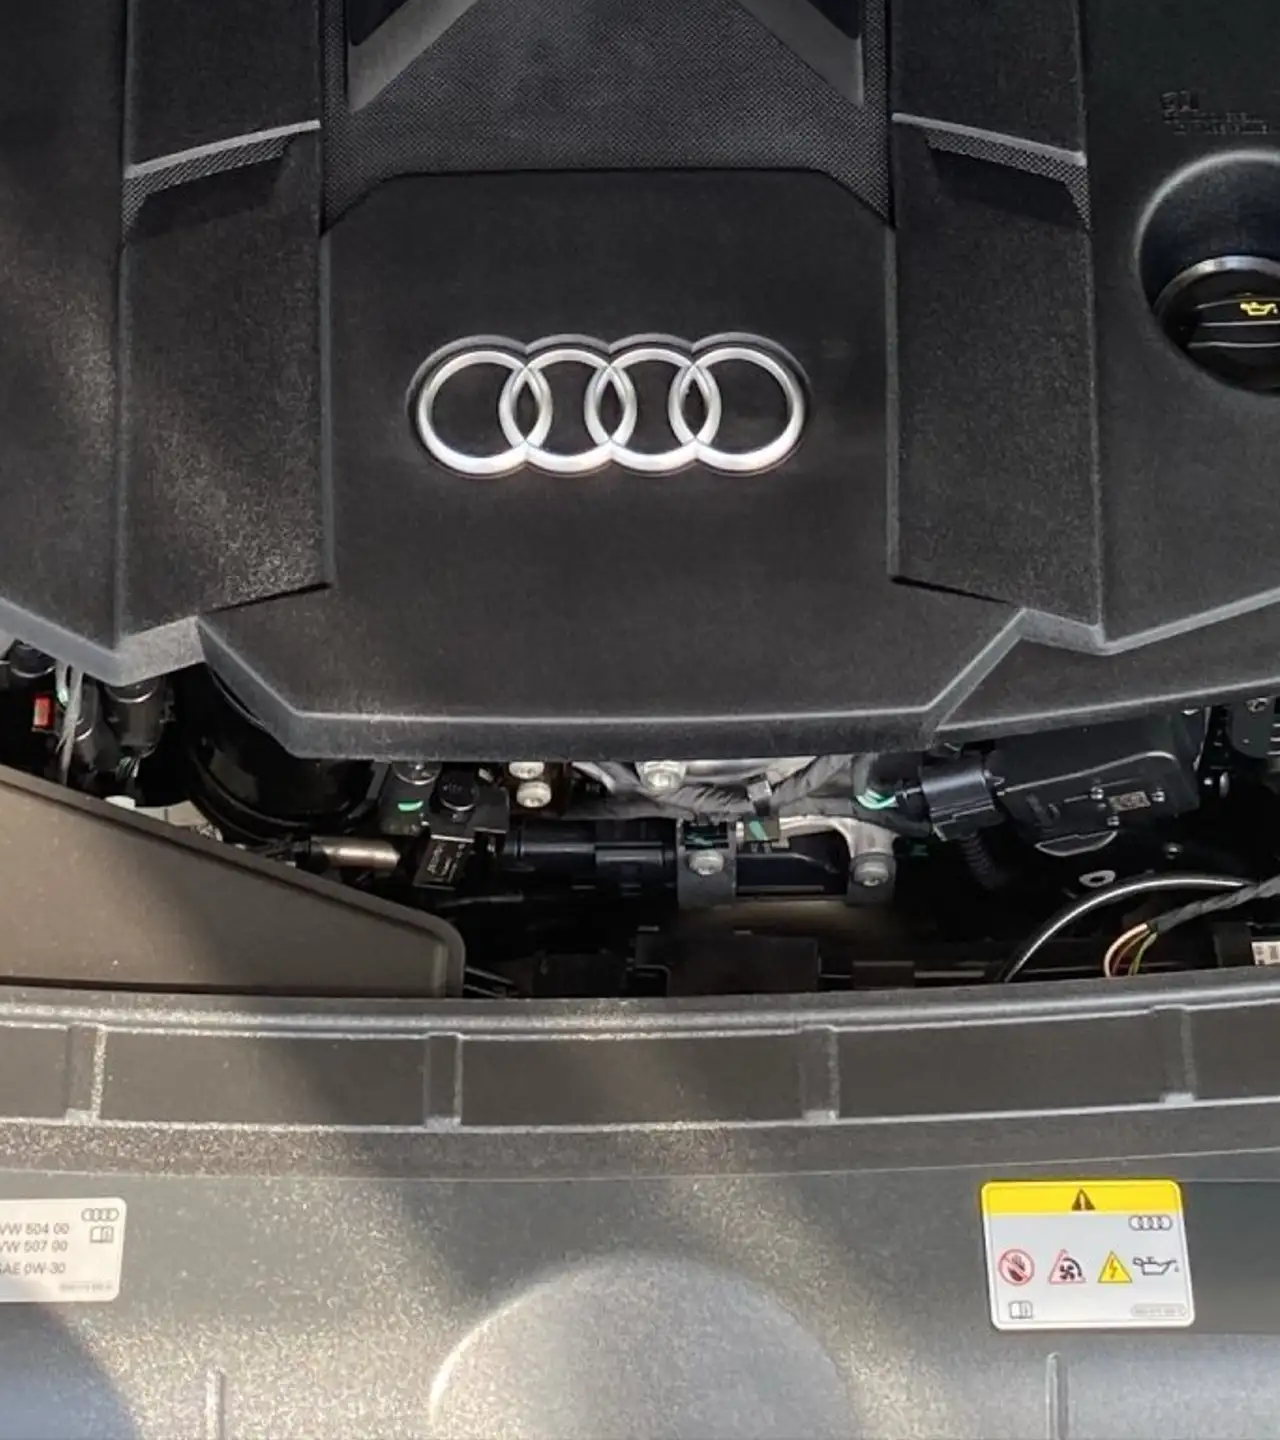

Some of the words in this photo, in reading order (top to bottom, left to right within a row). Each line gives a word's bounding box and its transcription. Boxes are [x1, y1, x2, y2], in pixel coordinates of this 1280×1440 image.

[25, 1222, 49, 1236] 504
[53, 1222, 70, 1235] 00
[23, 1240, 47, 1253] 507
[51, 1240, 69, 1253] 00
[23, 1262, 66, 1276] 0W-30
